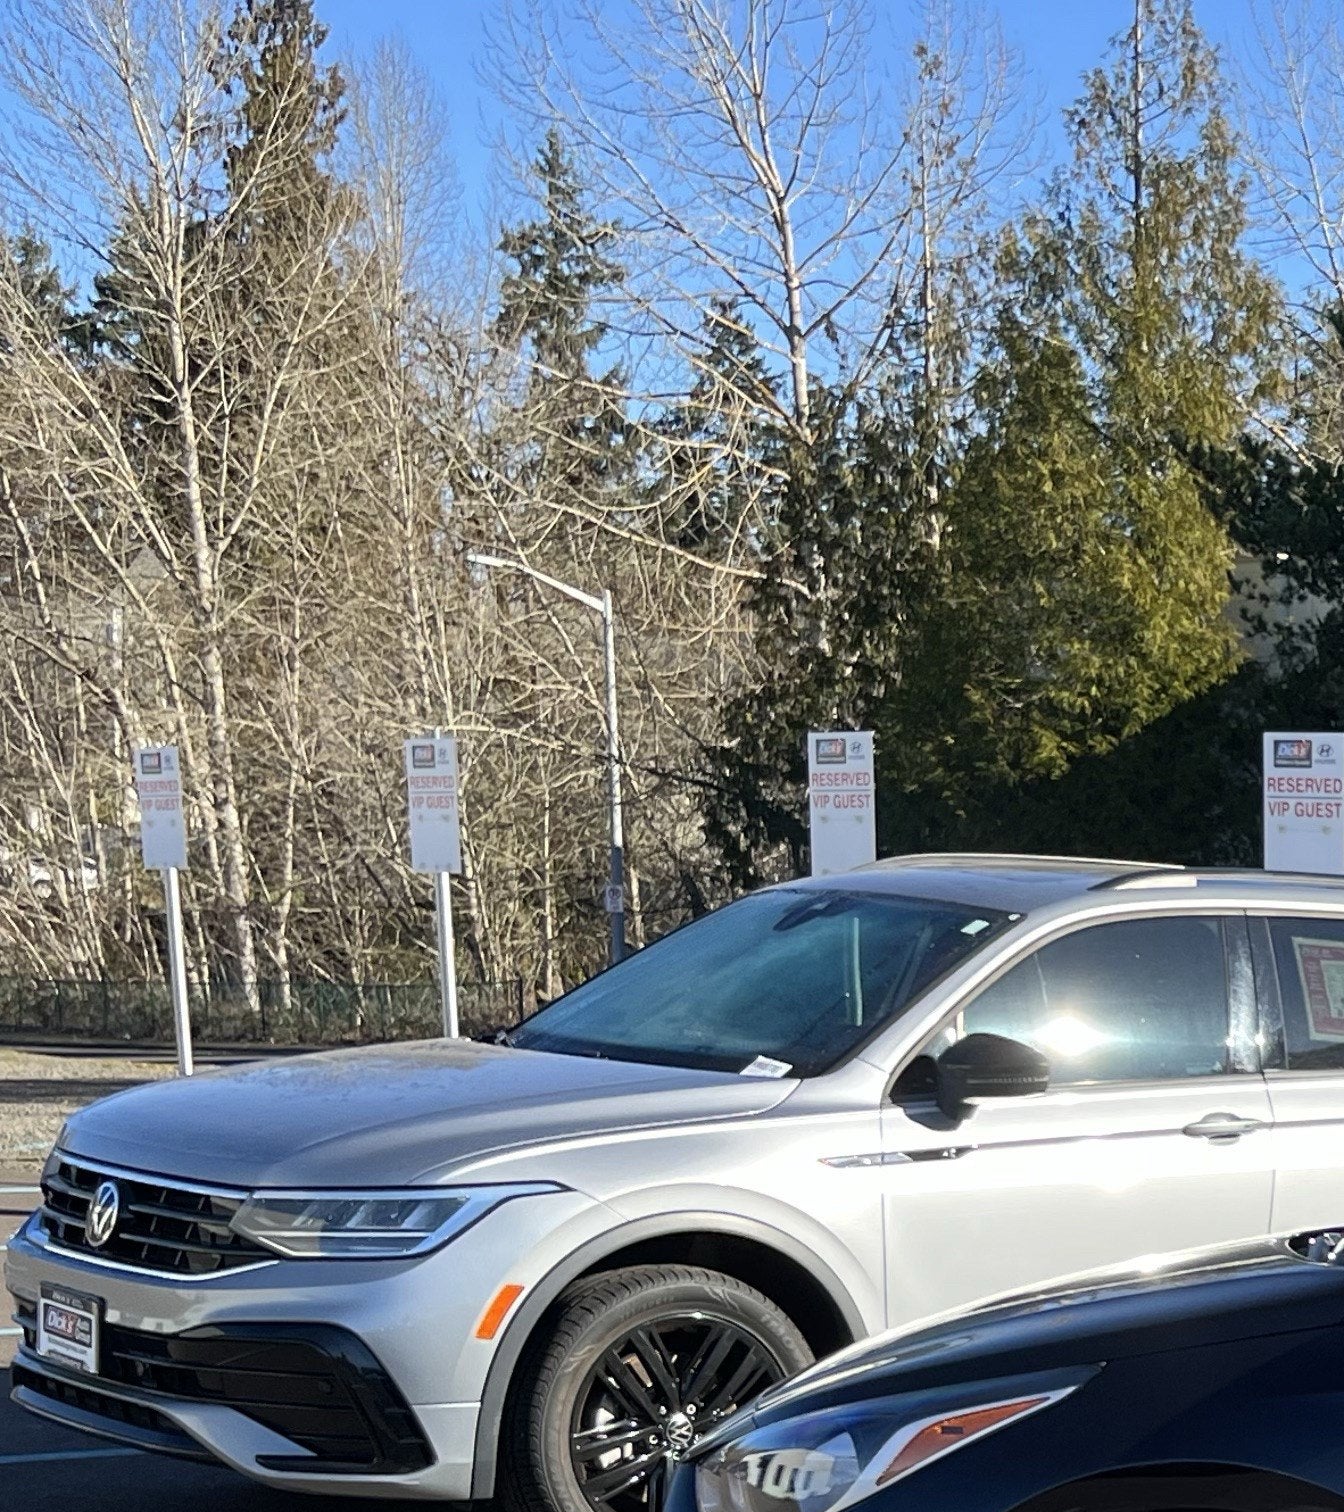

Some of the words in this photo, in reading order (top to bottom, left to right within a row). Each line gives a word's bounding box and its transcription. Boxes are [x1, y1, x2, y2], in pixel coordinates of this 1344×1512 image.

[410, 775, 454, 789] RESERVED
[811, 772, 871, 787] RESERVED
[1267, 777, 1343, 793] RESERVED
[426, 796, 454, 809] GUEST
[812, 795, 830, 809] VIP
[833, 794, 871, 809] GUEST
[1268, 801, 1290, 817] VIP
[1294, 802, 1342, 818] GUEST
